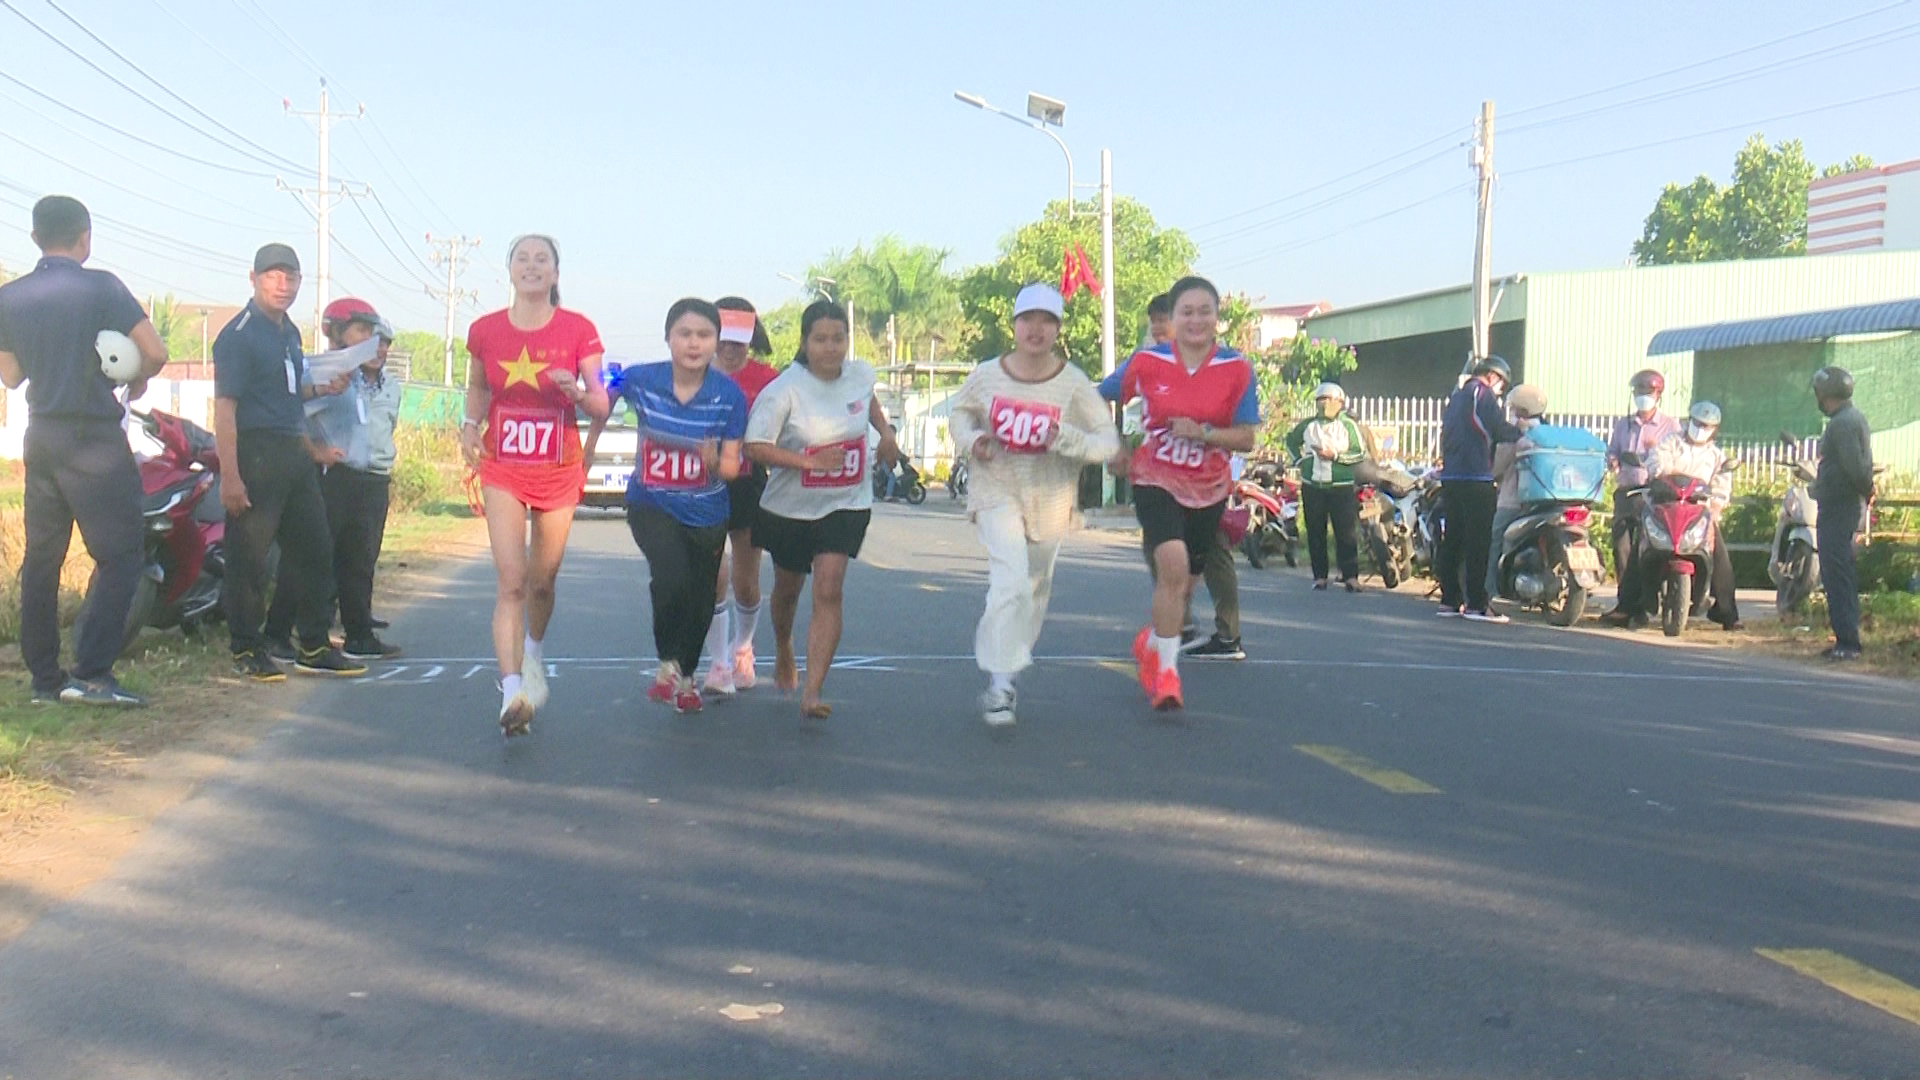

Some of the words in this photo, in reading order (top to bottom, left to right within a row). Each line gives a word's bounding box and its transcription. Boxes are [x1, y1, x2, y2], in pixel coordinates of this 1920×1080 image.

[502, 419, 554, 455] 207
[996, 408, 1050, 447] 203
[650, 449, 701, 480] 210
[1156, 434, 1204, 468] 205
